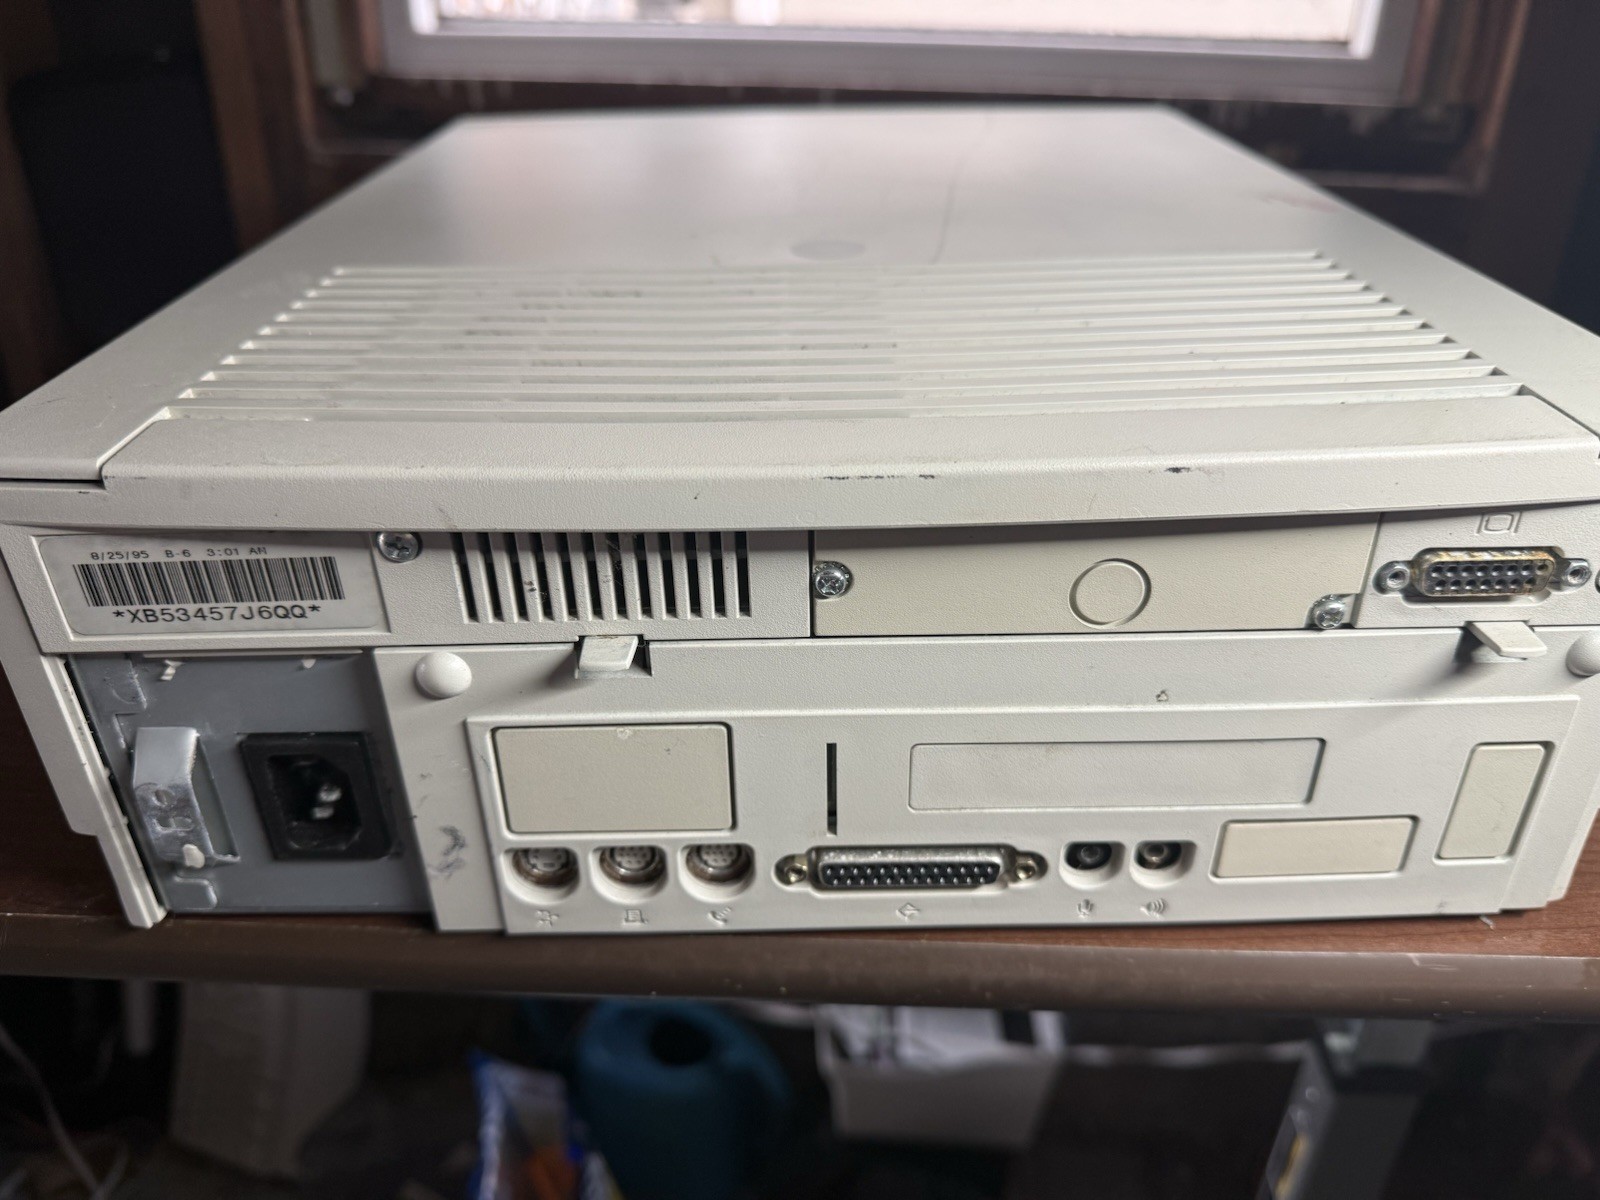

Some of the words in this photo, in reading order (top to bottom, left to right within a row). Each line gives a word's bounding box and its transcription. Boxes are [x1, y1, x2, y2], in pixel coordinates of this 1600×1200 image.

[90, 550, 149, 562] 8/25/95
[206, 547, 239, 557] 3:01
[249, 546, 267, 555] AM
